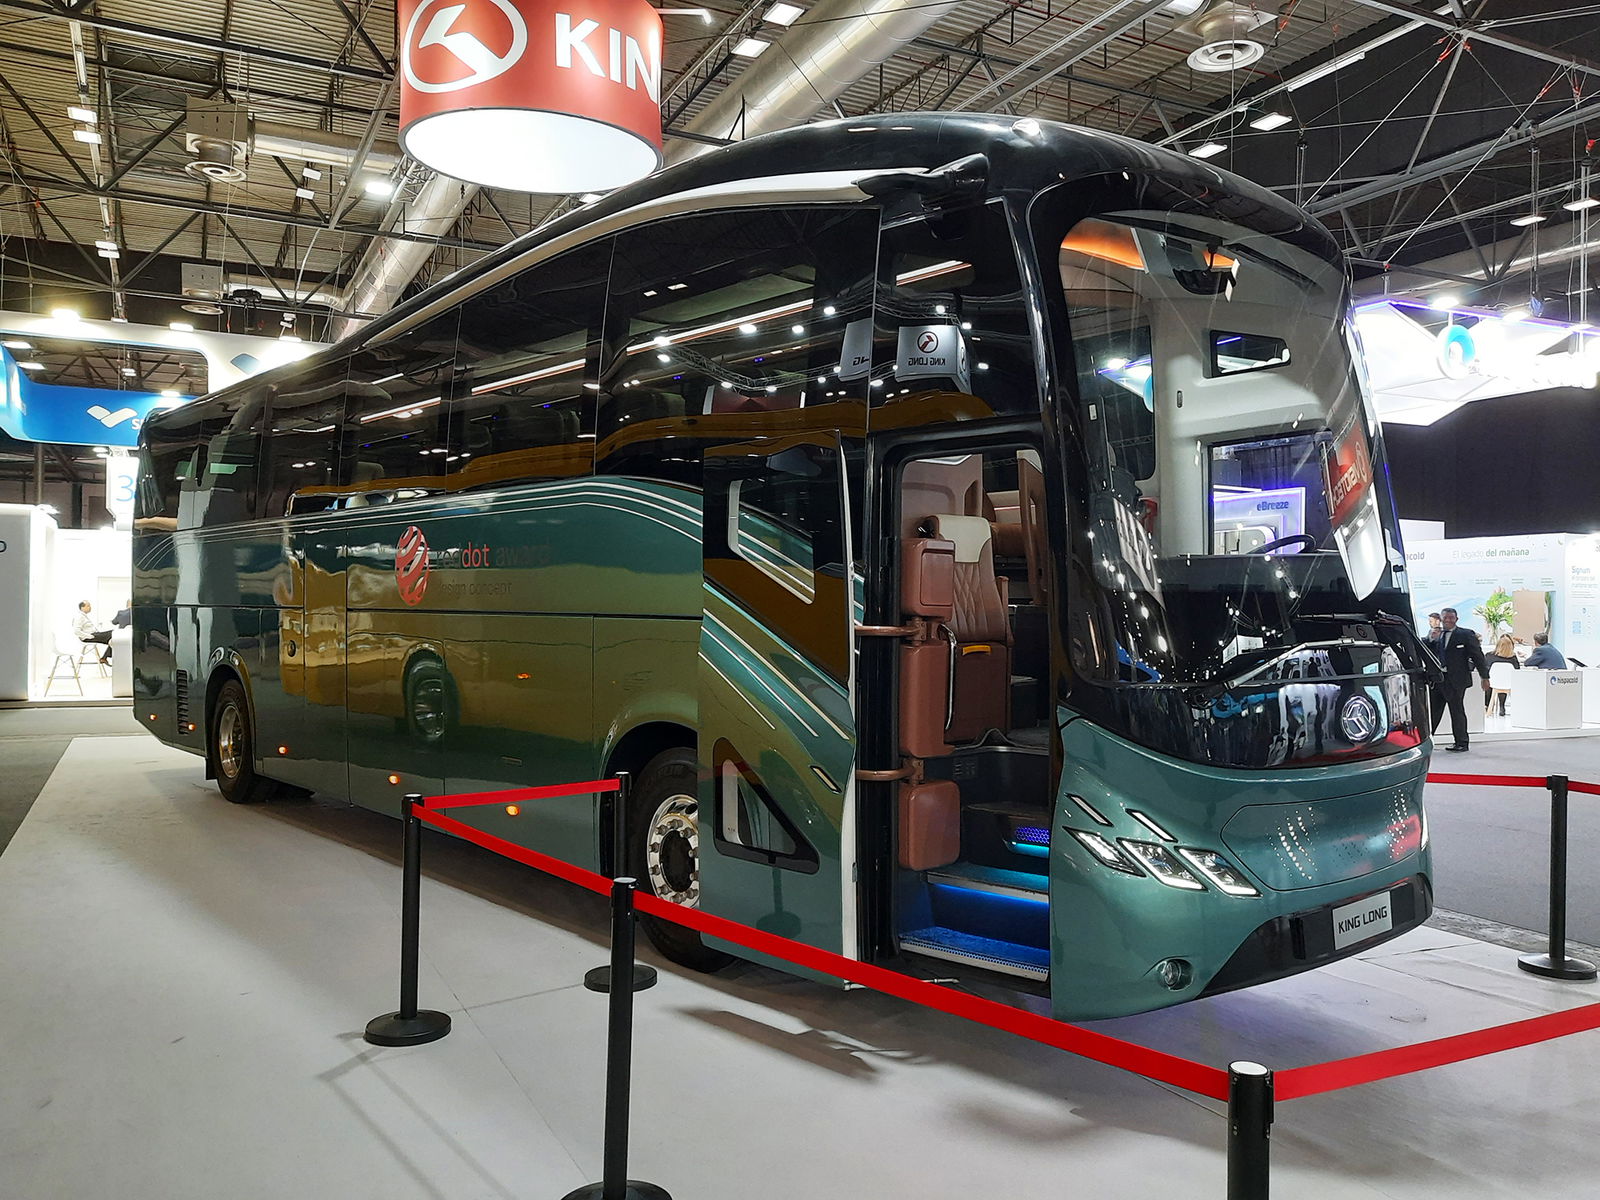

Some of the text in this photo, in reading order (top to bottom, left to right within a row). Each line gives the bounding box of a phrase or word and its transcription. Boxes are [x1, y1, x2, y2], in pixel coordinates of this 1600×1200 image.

[1486, 549, 1497, 557] del
[1499, 547, 1530, 557] mañana
[1338, 905, 1388, 934] KING LONG
